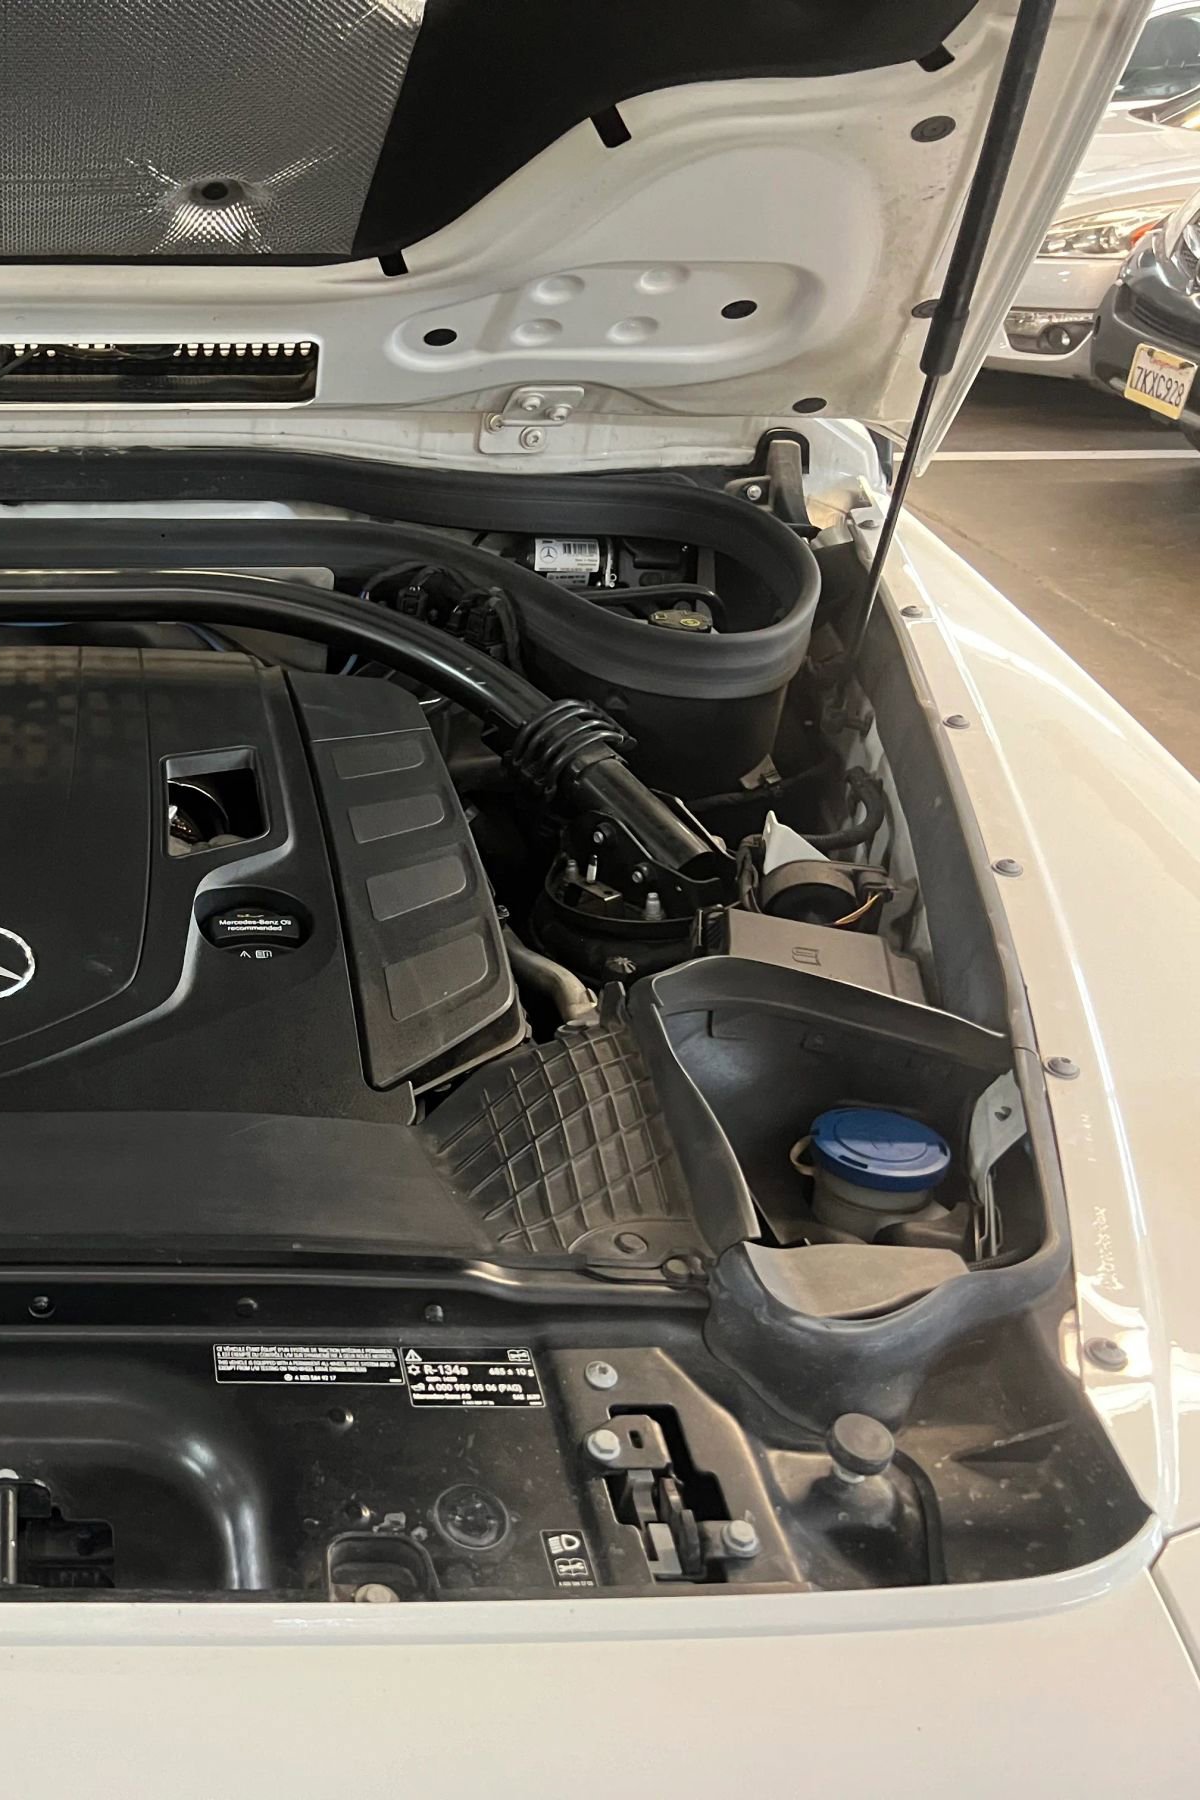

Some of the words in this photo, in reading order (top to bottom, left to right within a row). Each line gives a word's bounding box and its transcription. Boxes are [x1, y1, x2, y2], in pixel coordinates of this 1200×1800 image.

[1135, 365, 1185, 407] 7KXC928
[423, 1364, 468, 1376] R-134a
[515, 1368, 527, 1376] 10
[435, 1384, 453, 1392] 000
[498, 1383, 523, 1393] (PAG)
